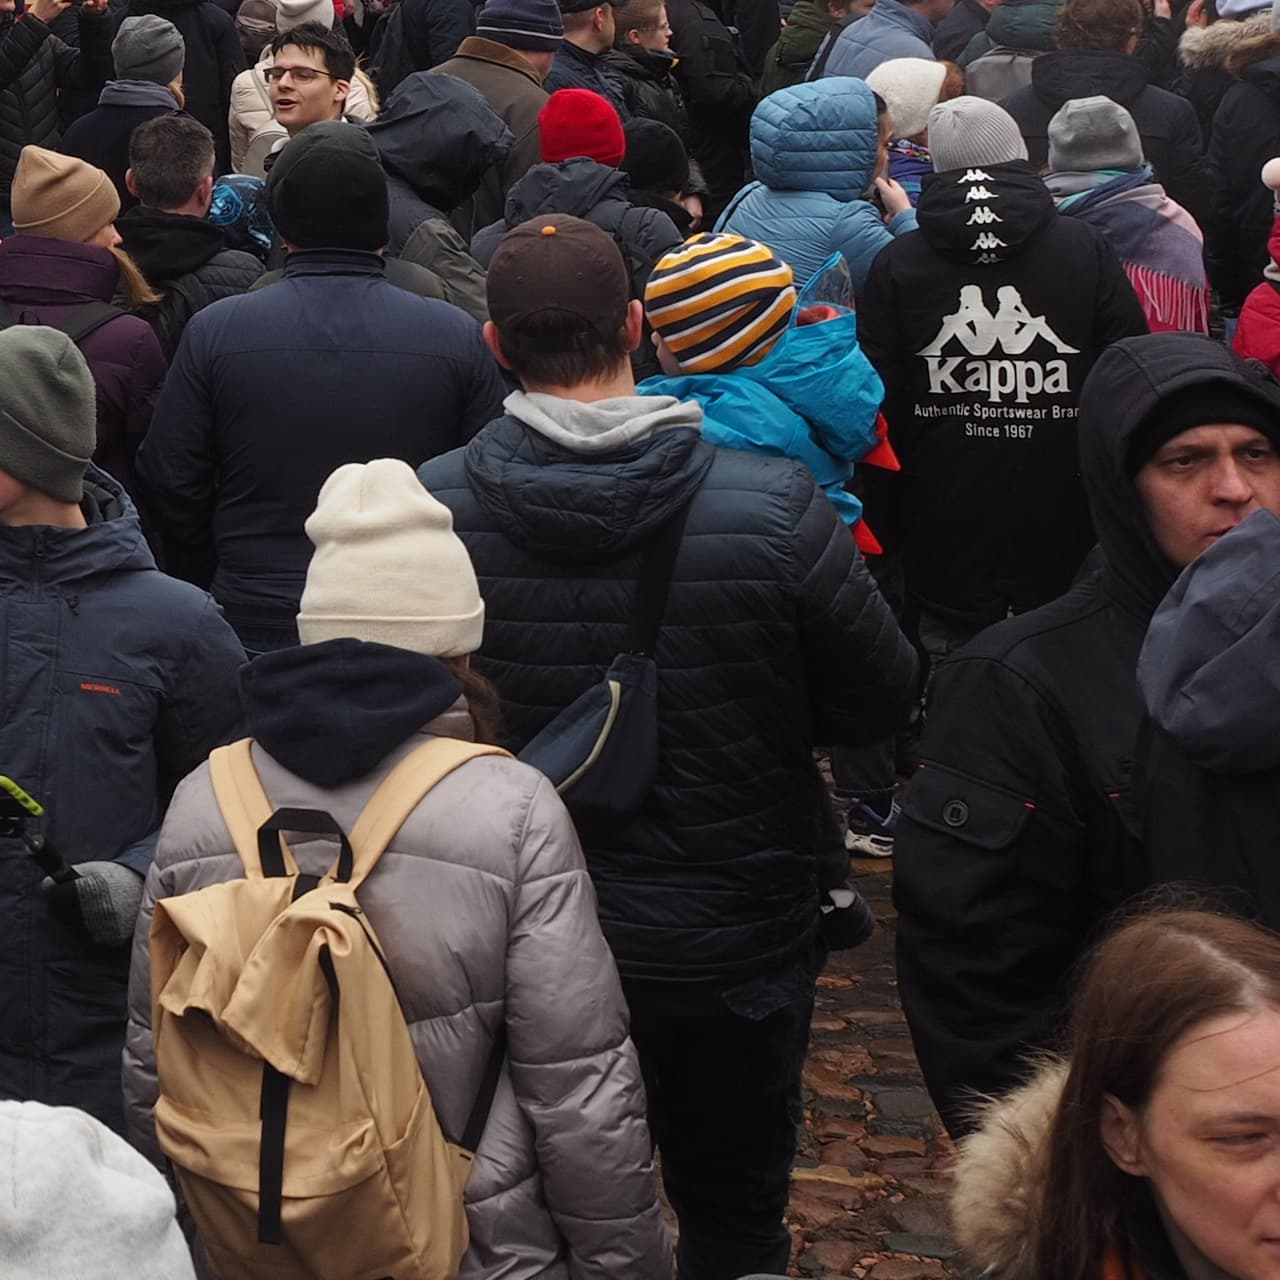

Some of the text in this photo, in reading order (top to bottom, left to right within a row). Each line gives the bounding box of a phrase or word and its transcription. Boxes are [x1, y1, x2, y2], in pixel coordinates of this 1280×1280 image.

[924, 355, 1072, 404] Kappa
[914, 402, 971, 418] Authentic
[973, 403, 1048, 420] Sportswear
[965, 422, 1034, 439] Since 1967
